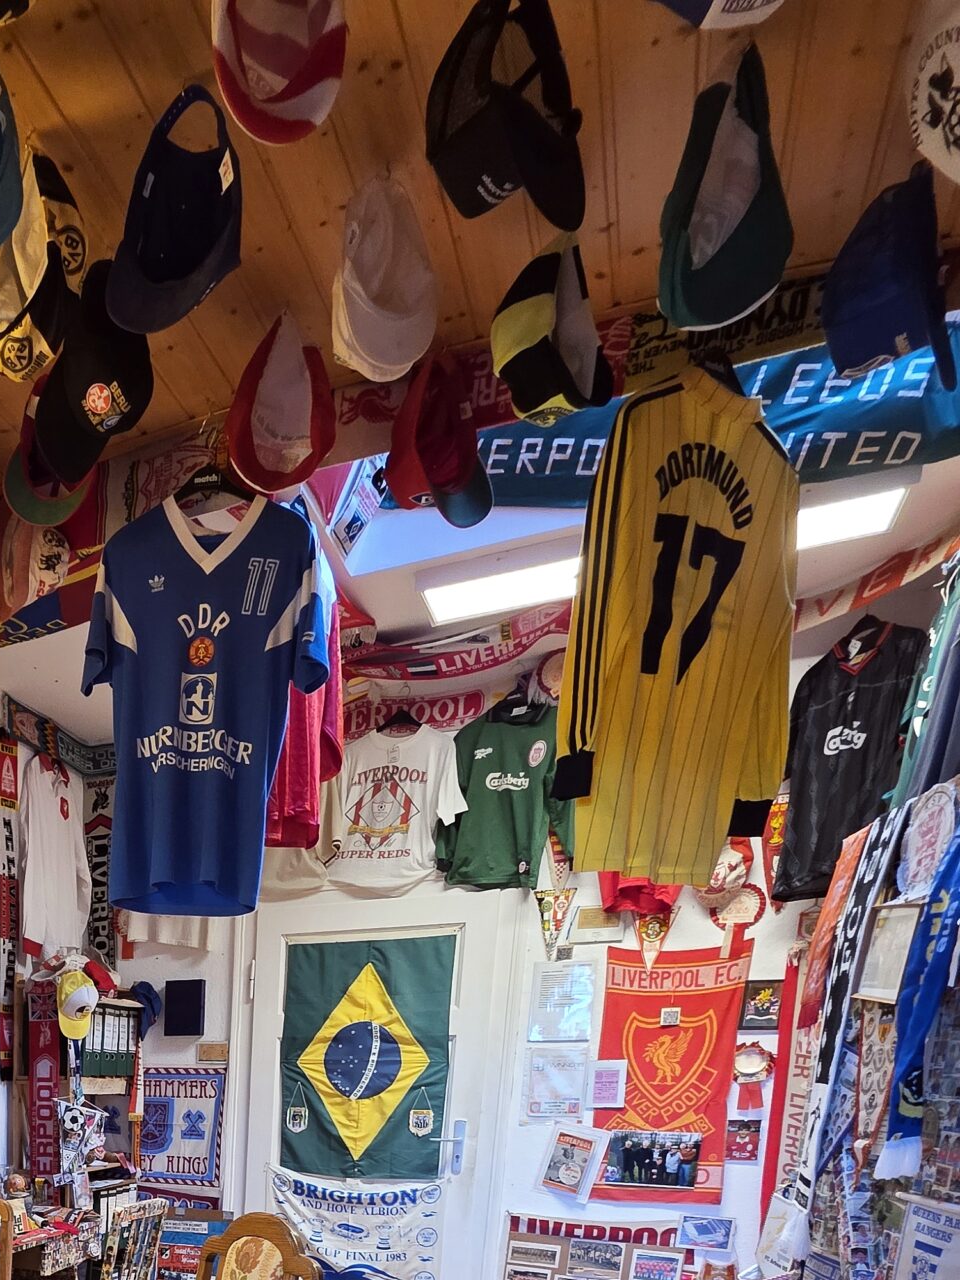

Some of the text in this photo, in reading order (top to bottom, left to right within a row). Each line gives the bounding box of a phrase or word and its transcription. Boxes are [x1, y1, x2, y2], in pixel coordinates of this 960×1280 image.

[749, 356, 936, 405] LEEDS
[193, 473, 218, 484] match
[655, 442, 756, 531] DORTMUND
[241, 557, 280, 616] 11
[640, 513, 746, 686] 17
[177, 603, 231, 639] DDR
[350, 766, 428, 787] LIVERPOOL
[485, 771, 530, 792] Carlsberg
[377, 848, 411, 859] REDS
[611, 962, 743, 989] LIVERPOOL F.C.
[144, 1078, 218, 1100] HAMMERS
[292, 1179, 419, 1207] BRIGHTON
[300, 1198, 408, 1216] AND HOVE ALBION
[912, 1204, 942, 1223] QUEENS
[914, 1221, 954, 1243] RANGERS
[316, 1245, 342, 1259] CUP
[345, 1251, 383, 1263] FINAL
[385, 1252, 408, 1263] 1983
